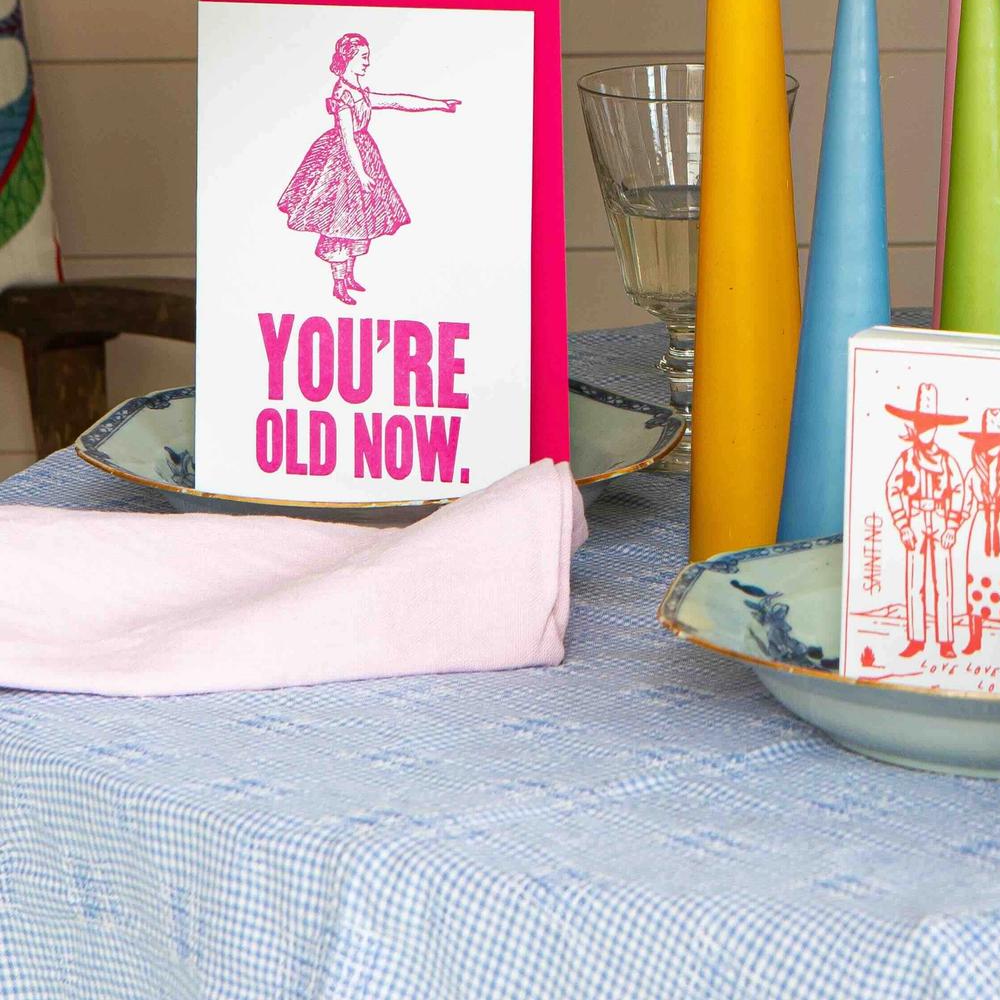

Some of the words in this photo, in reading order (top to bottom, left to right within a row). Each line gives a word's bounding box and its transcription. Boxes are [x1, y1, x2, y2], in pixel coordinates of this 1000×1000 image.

[257, 312, 470, 410] YOU'RE
[255, 408, 337, 476] OLD
[353, 411, 470, 484] NOW.
